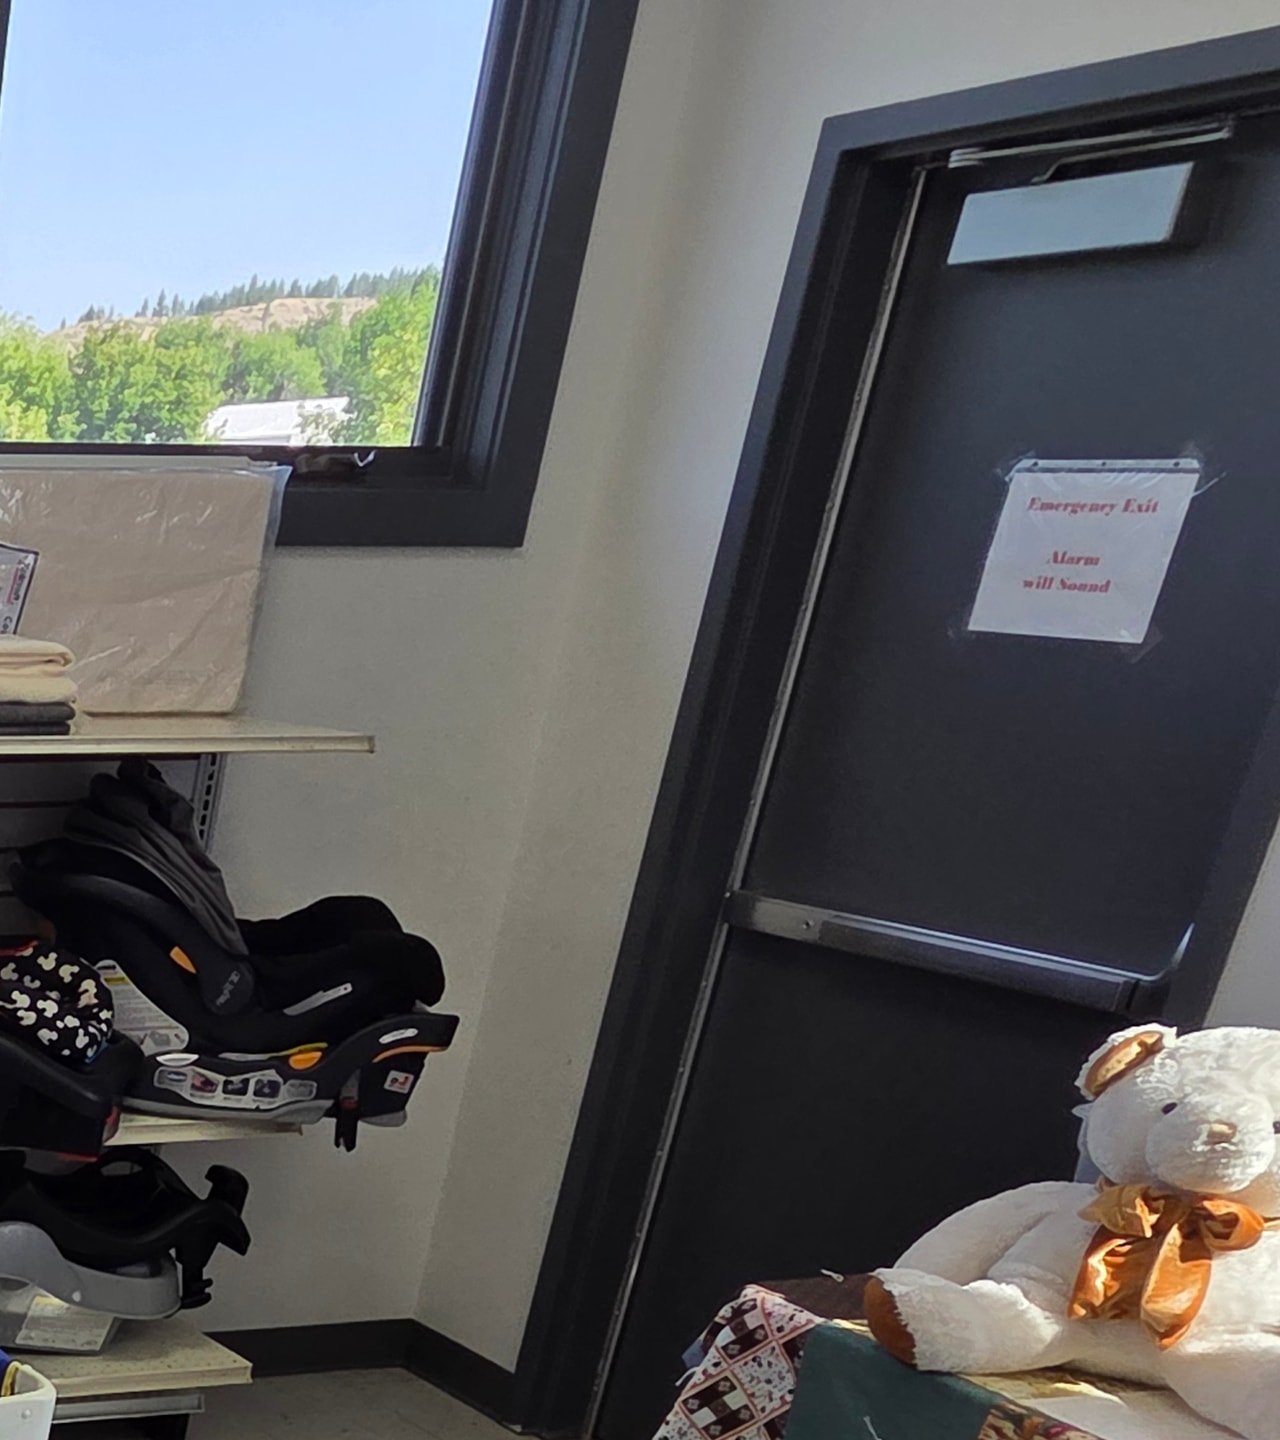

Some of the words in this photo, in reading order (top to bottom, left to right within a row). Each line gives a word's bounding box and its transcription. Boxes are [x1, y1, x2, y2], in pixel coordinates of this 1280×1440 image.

[1027, 497, 1117, 517] Emergency
[1122, 498, 1158, 514] Exit
[1046, 551, 1100, 566] Alarm
[1023, 576, 1054, 590] will
[1057, 577, 1111, 593] Sound
